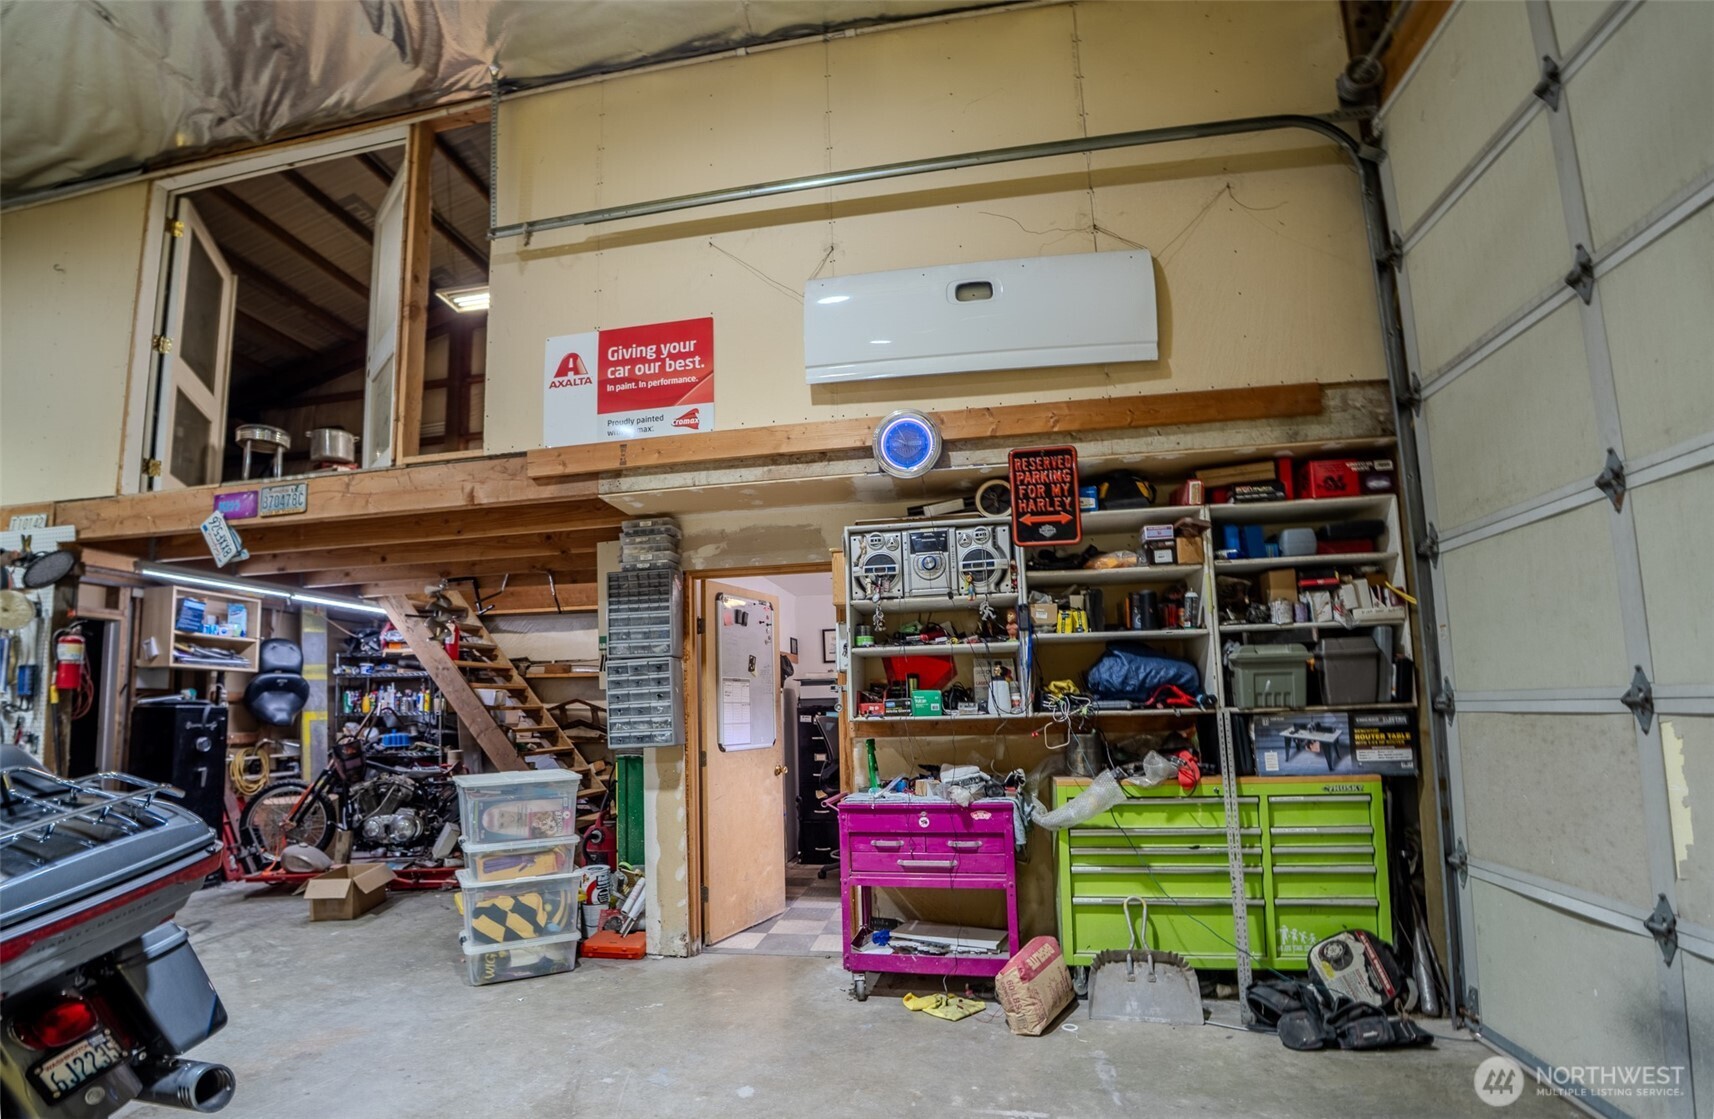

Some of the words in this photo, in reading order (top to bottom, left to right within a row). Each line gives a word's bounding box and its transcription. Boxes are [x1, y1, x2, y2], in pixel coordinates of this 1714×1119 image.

[607, 344, 656, 362] Giving
[660, 339, 697, 357] your
[606, 365, 631, 379] car
[635, 361, 661, 376] our
[665, 355, 705, 373] best.
[549, 376, 593, 389] AXALTA
[606, 383, 615, 392] In
[615, 380, 637, 393] paint.
[638, 379, 647, 388] In
[647, 374, 699, 390] performance.
[607, 417, 635, 428] Proudly
[636, 414, 664, 425] painted
[1014, 455, 1072, 471] RESERVED
[1015, 469, 1072, 484] PARKING
[1018, 484, 1046, 499] FOR
[1051, 483, 1071, 497] MY
[1018, 497, 1072, 512] HARLEY
[1386, 731, 1411, 740] TABLE
